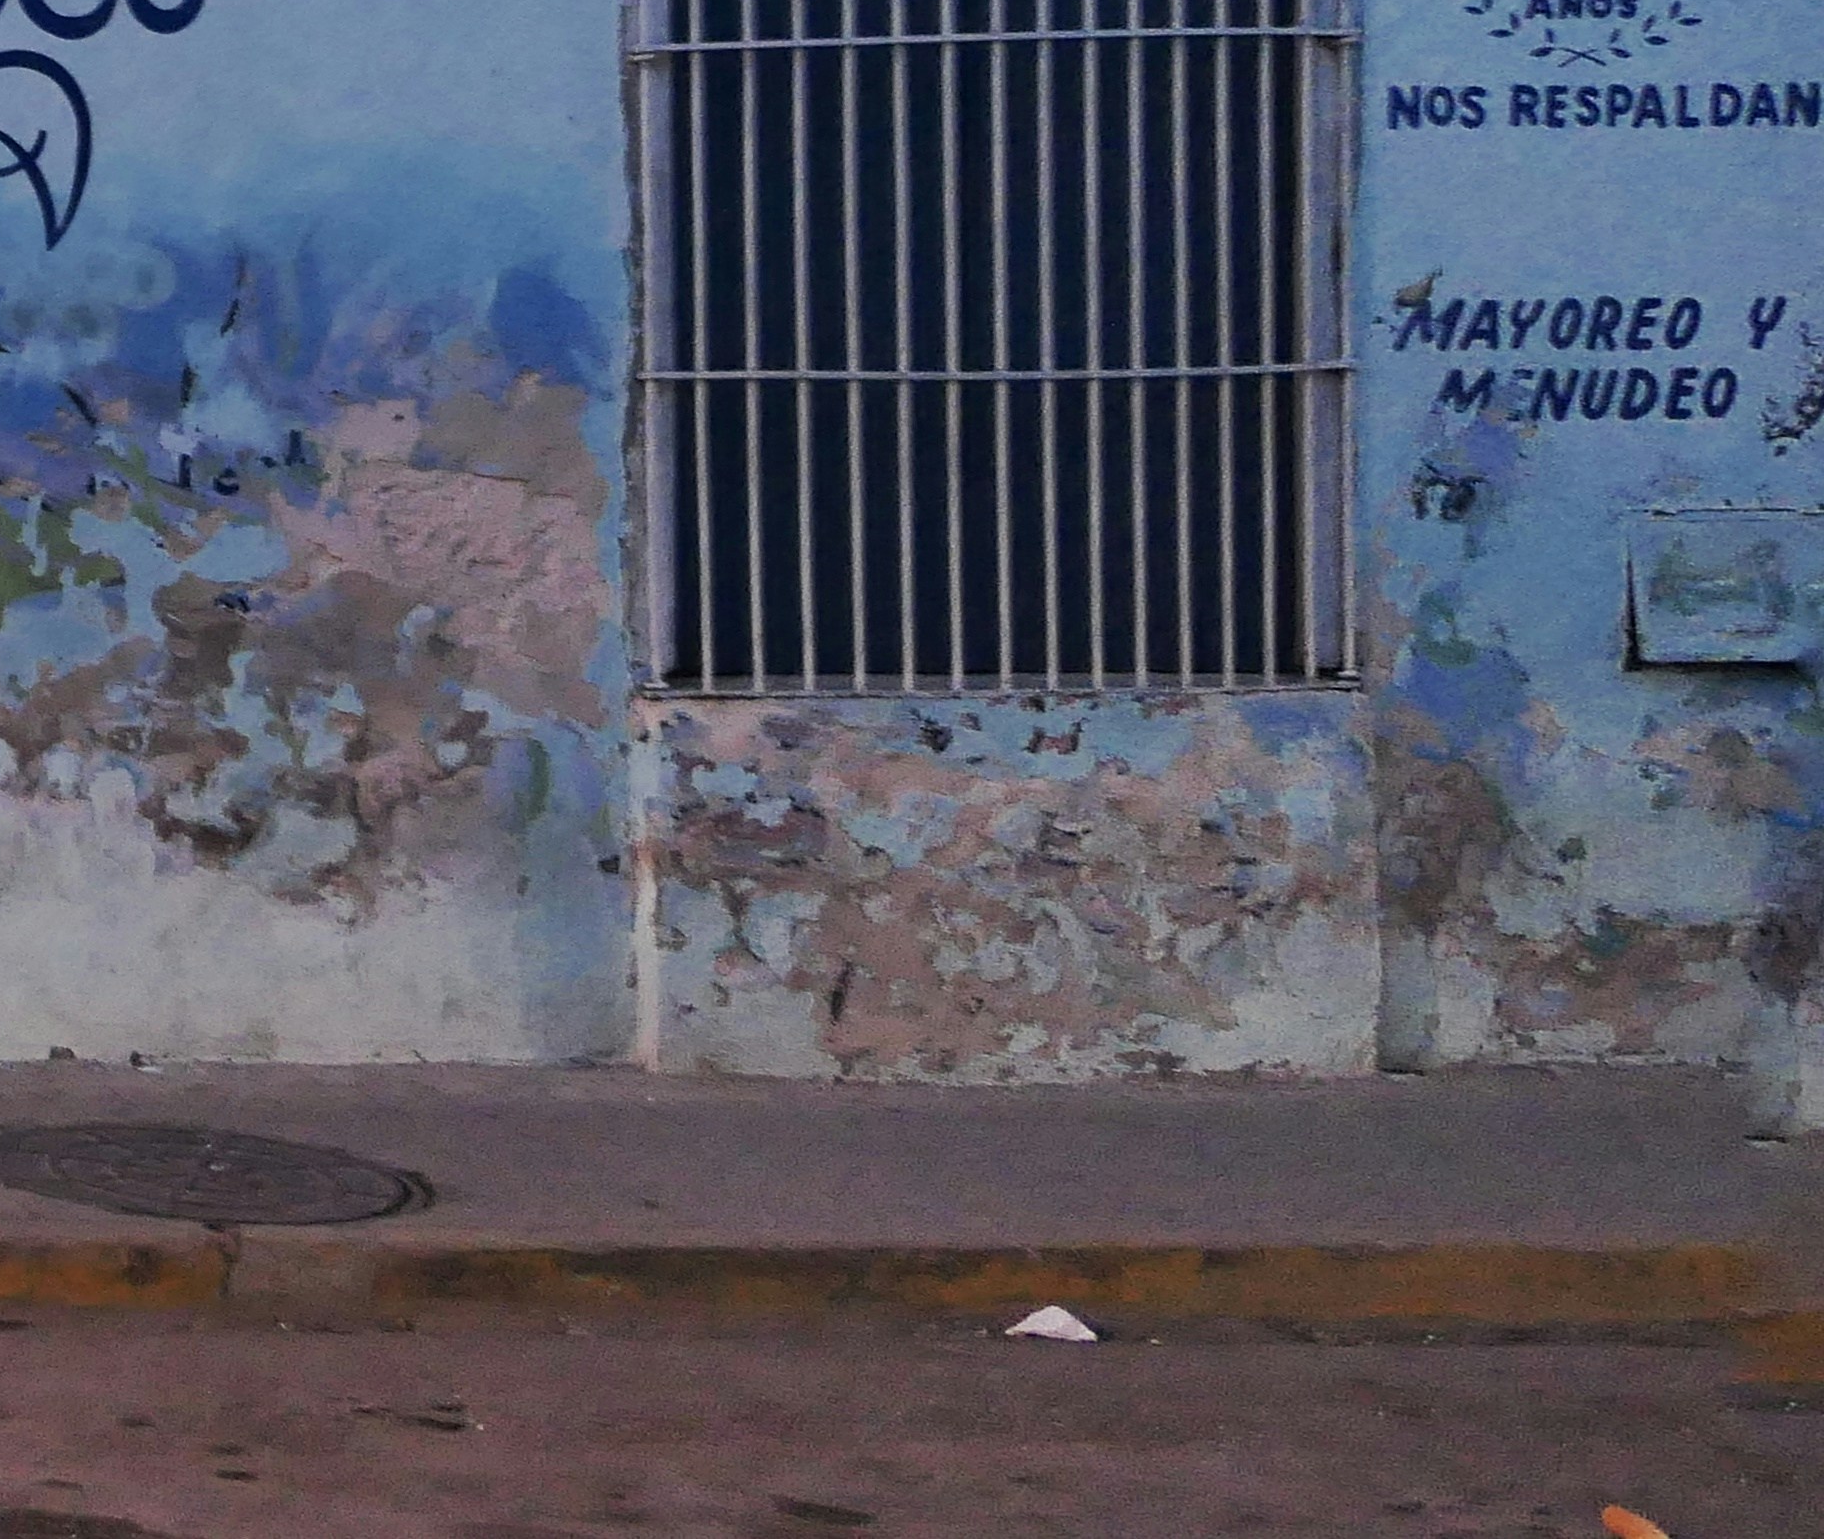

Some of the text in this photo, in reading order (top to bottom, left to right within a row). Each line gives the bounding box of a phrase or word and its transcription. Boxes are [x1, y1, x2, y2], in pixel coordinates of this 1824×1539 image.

[1387, 81, 1820, 129] NOS RESPALDAN
[1392, 295, 1786, 351] MAYOREO Y
